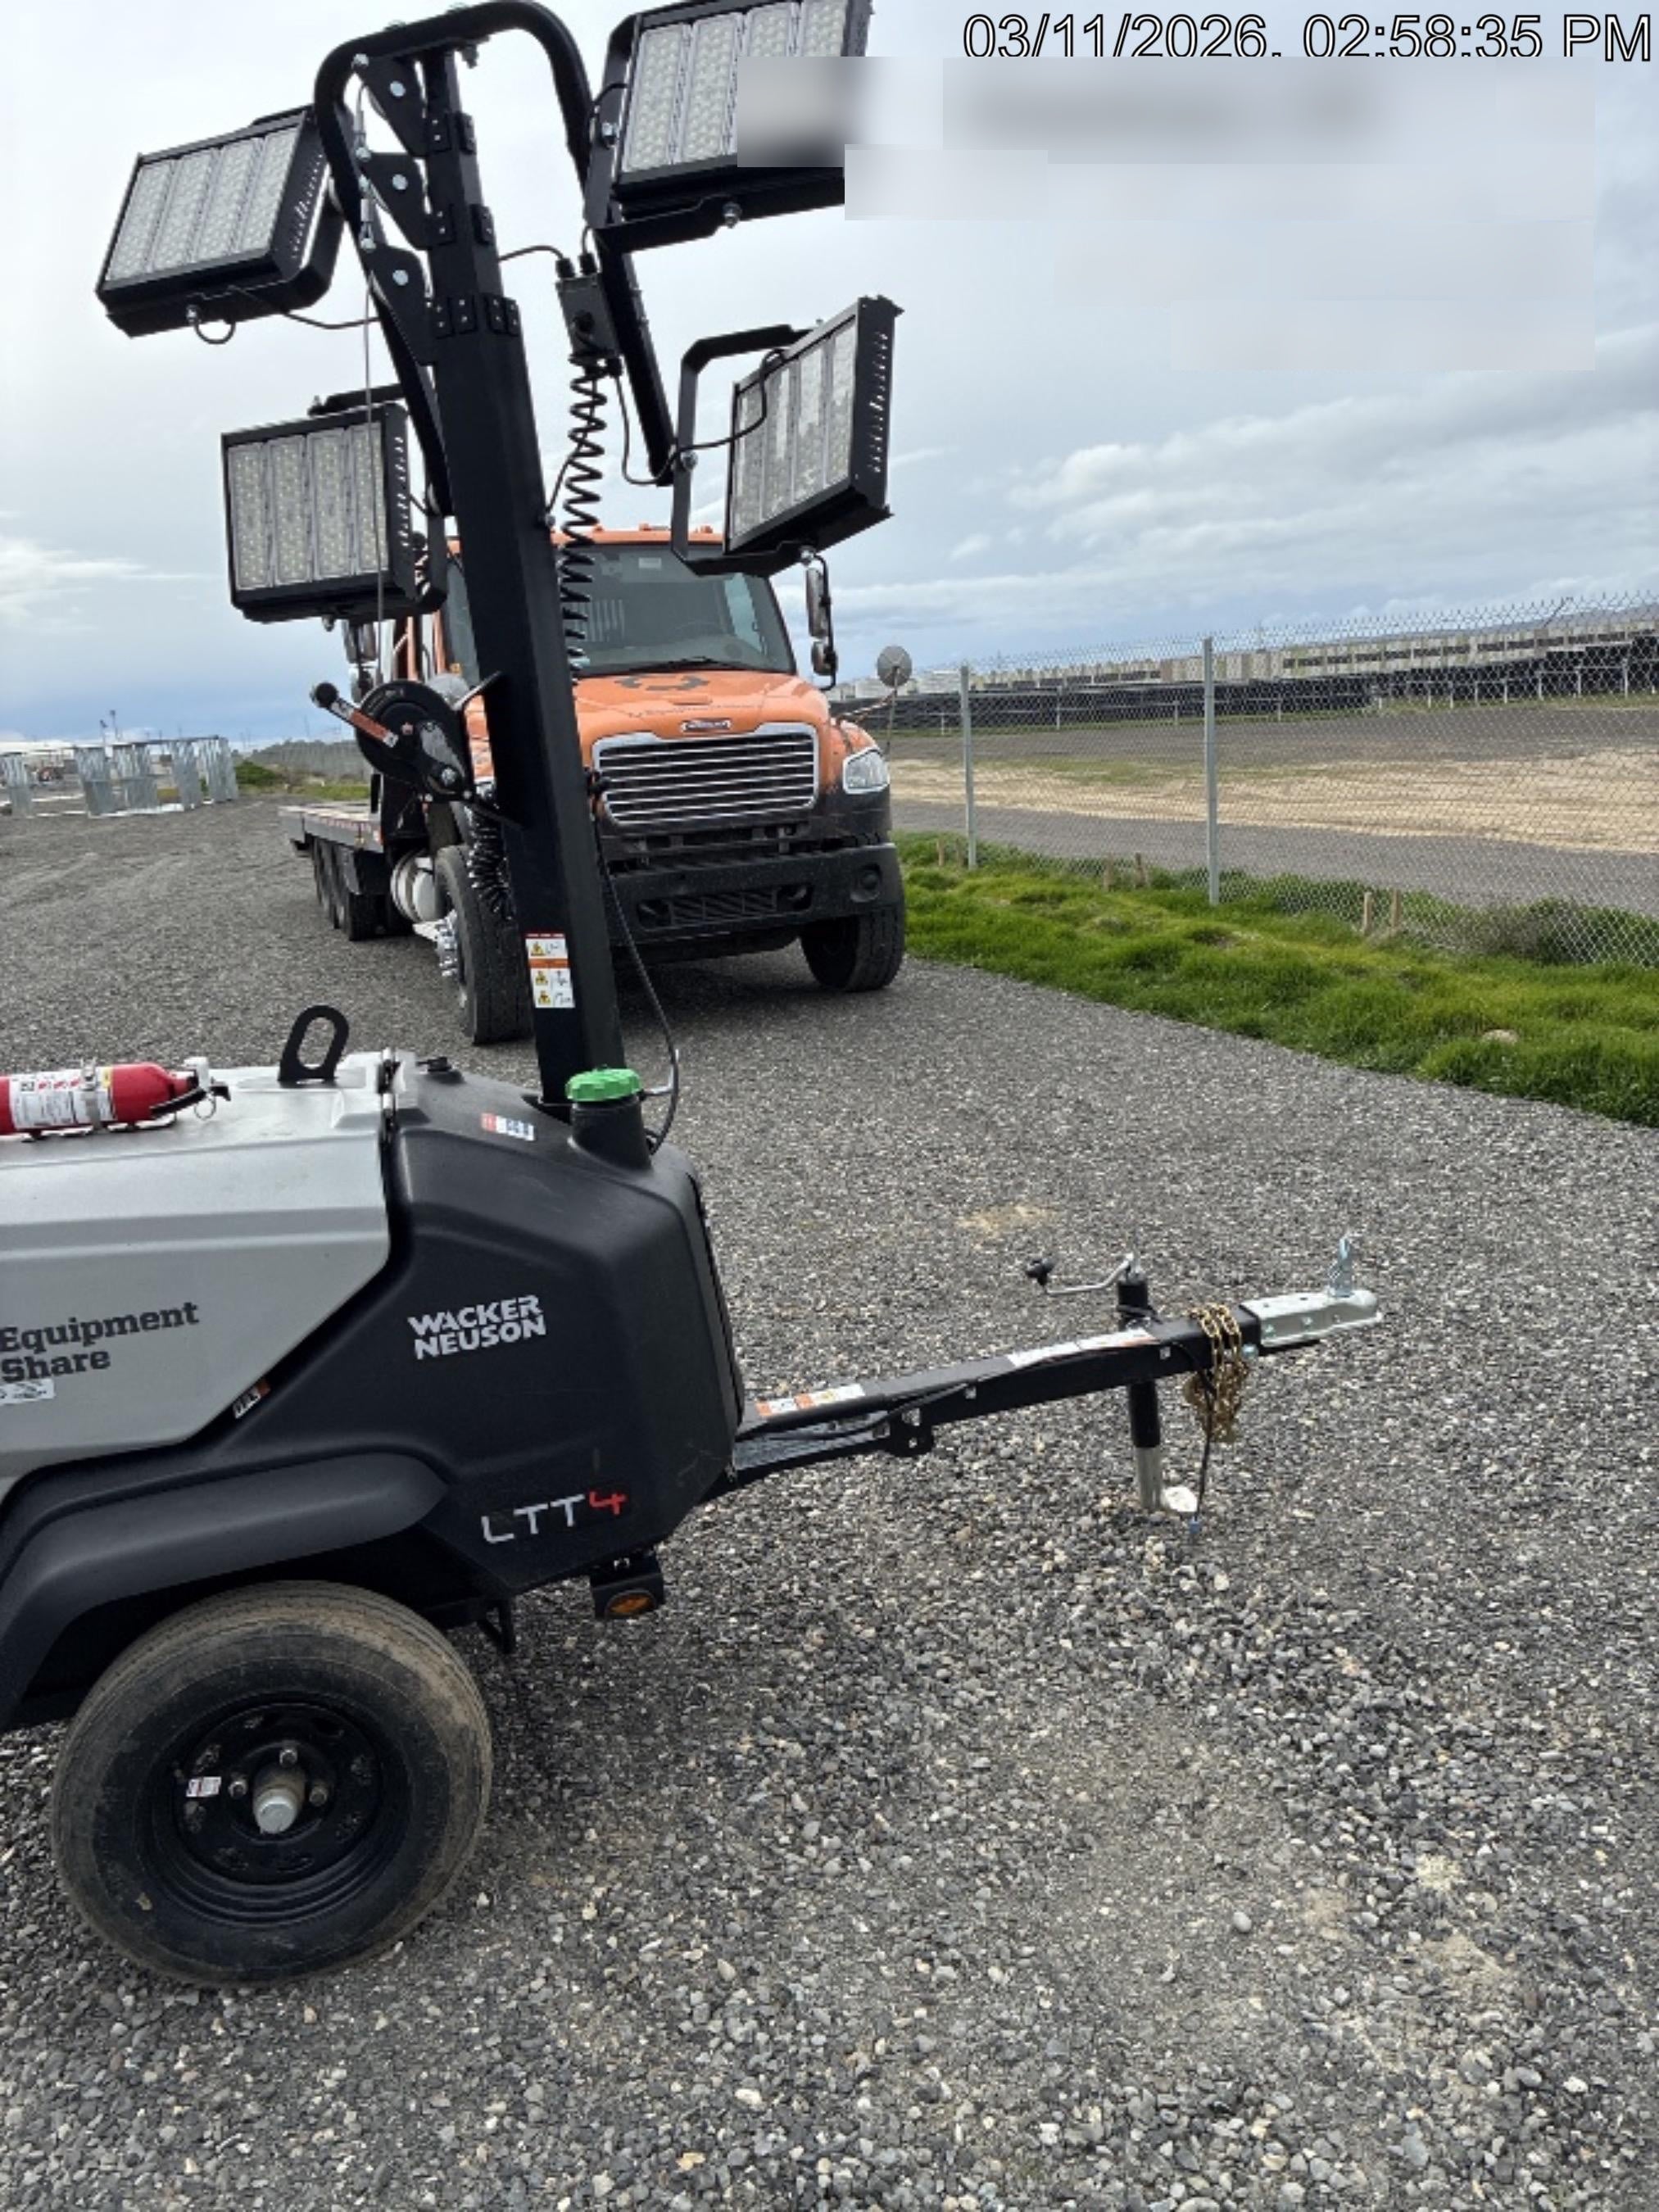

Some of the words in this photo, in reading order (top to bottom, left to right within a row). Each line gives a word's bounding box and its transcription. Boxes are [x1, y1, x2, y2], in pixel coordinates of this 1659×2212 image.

[0, 1302, 199, 1353] Equipment
[408, 1294, 542, 1336] WACKER
[414, 1315, 546, 1360] NEUSON
[1, 1350, 111, 1383] Share
